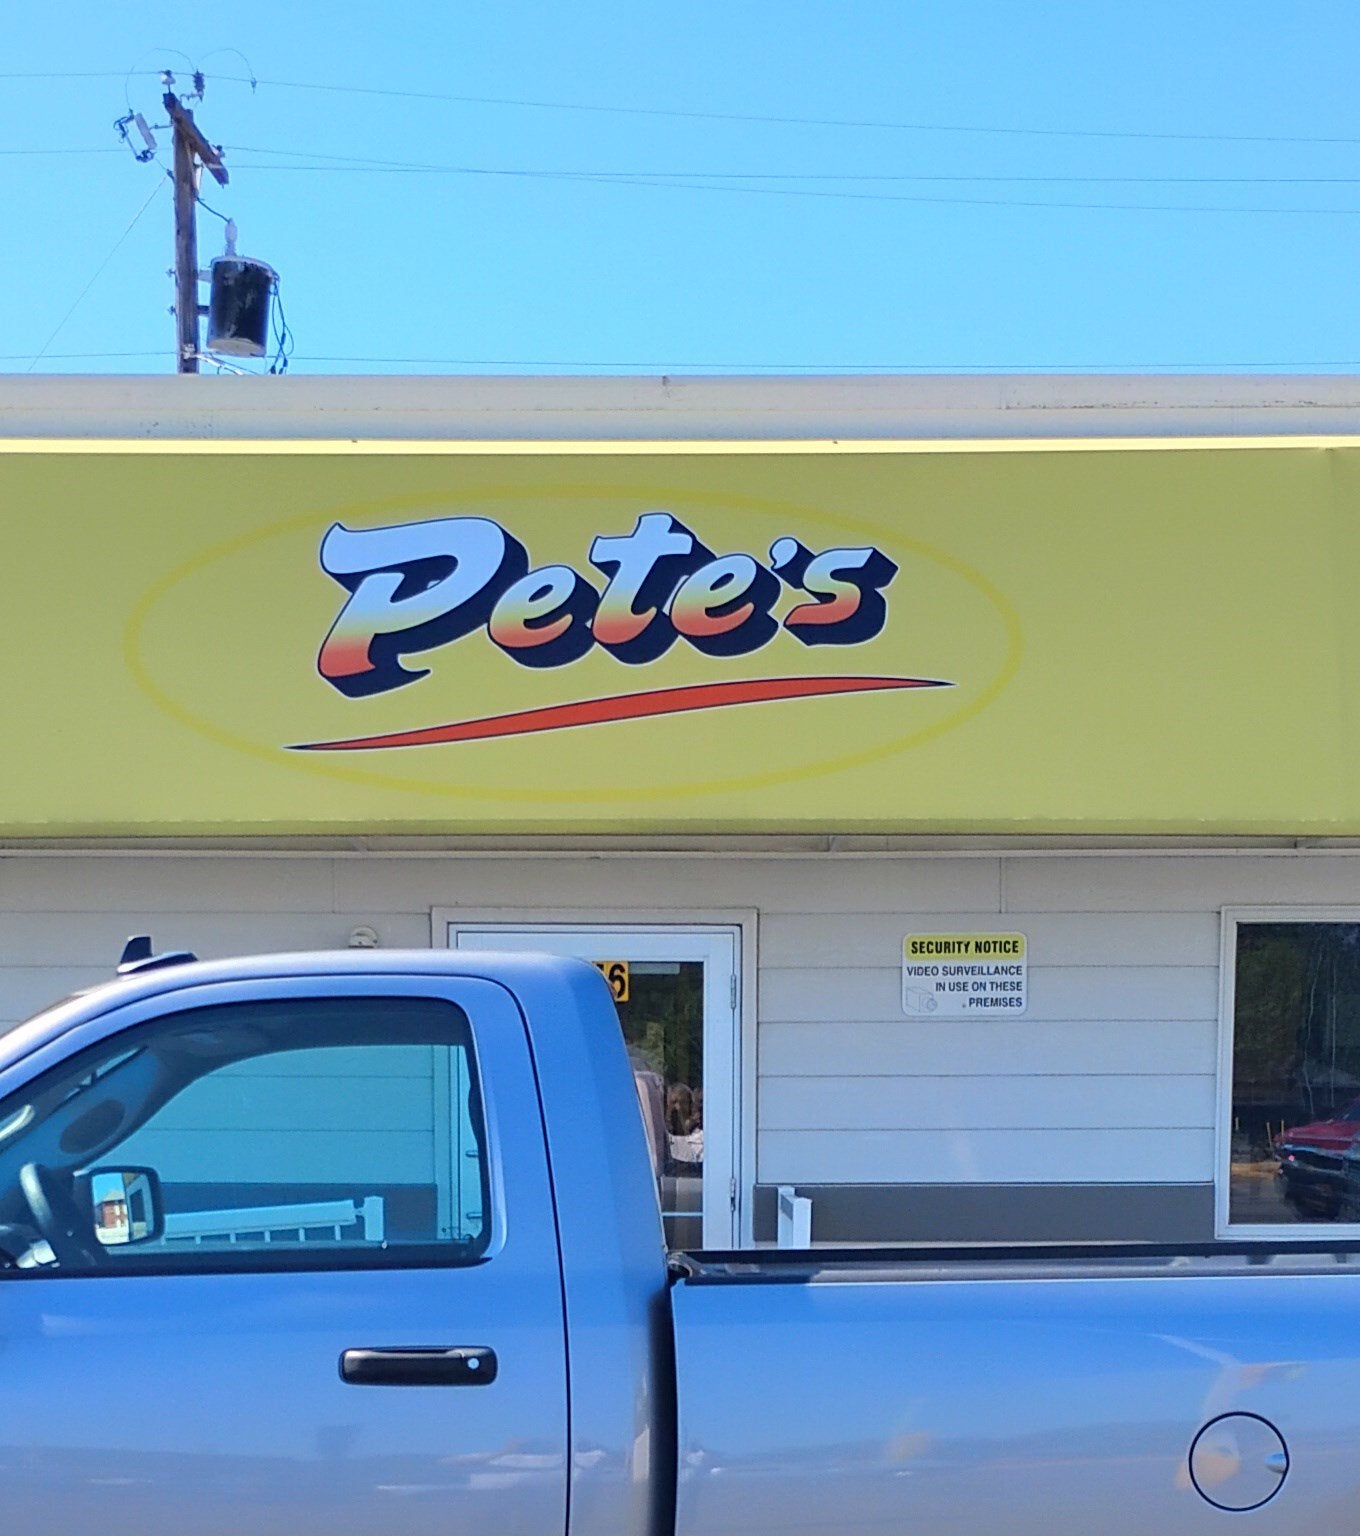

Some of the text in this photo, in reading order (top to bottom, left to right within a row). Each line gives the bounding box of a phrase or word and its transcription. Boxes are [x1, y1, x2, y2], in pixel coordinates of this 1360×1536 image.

[317, 512, 899, 699] Pete's
[911, 940, 1019, 954] SECURITY NOTICE
[906, 965, 1023, 976] VIDEO SURVEILLANCE
[595, 963, 626, 999] 6
[935, 981, 1023, 992] IN USE ON THESE
[968, 997, 1023, 1008] PREMISES
